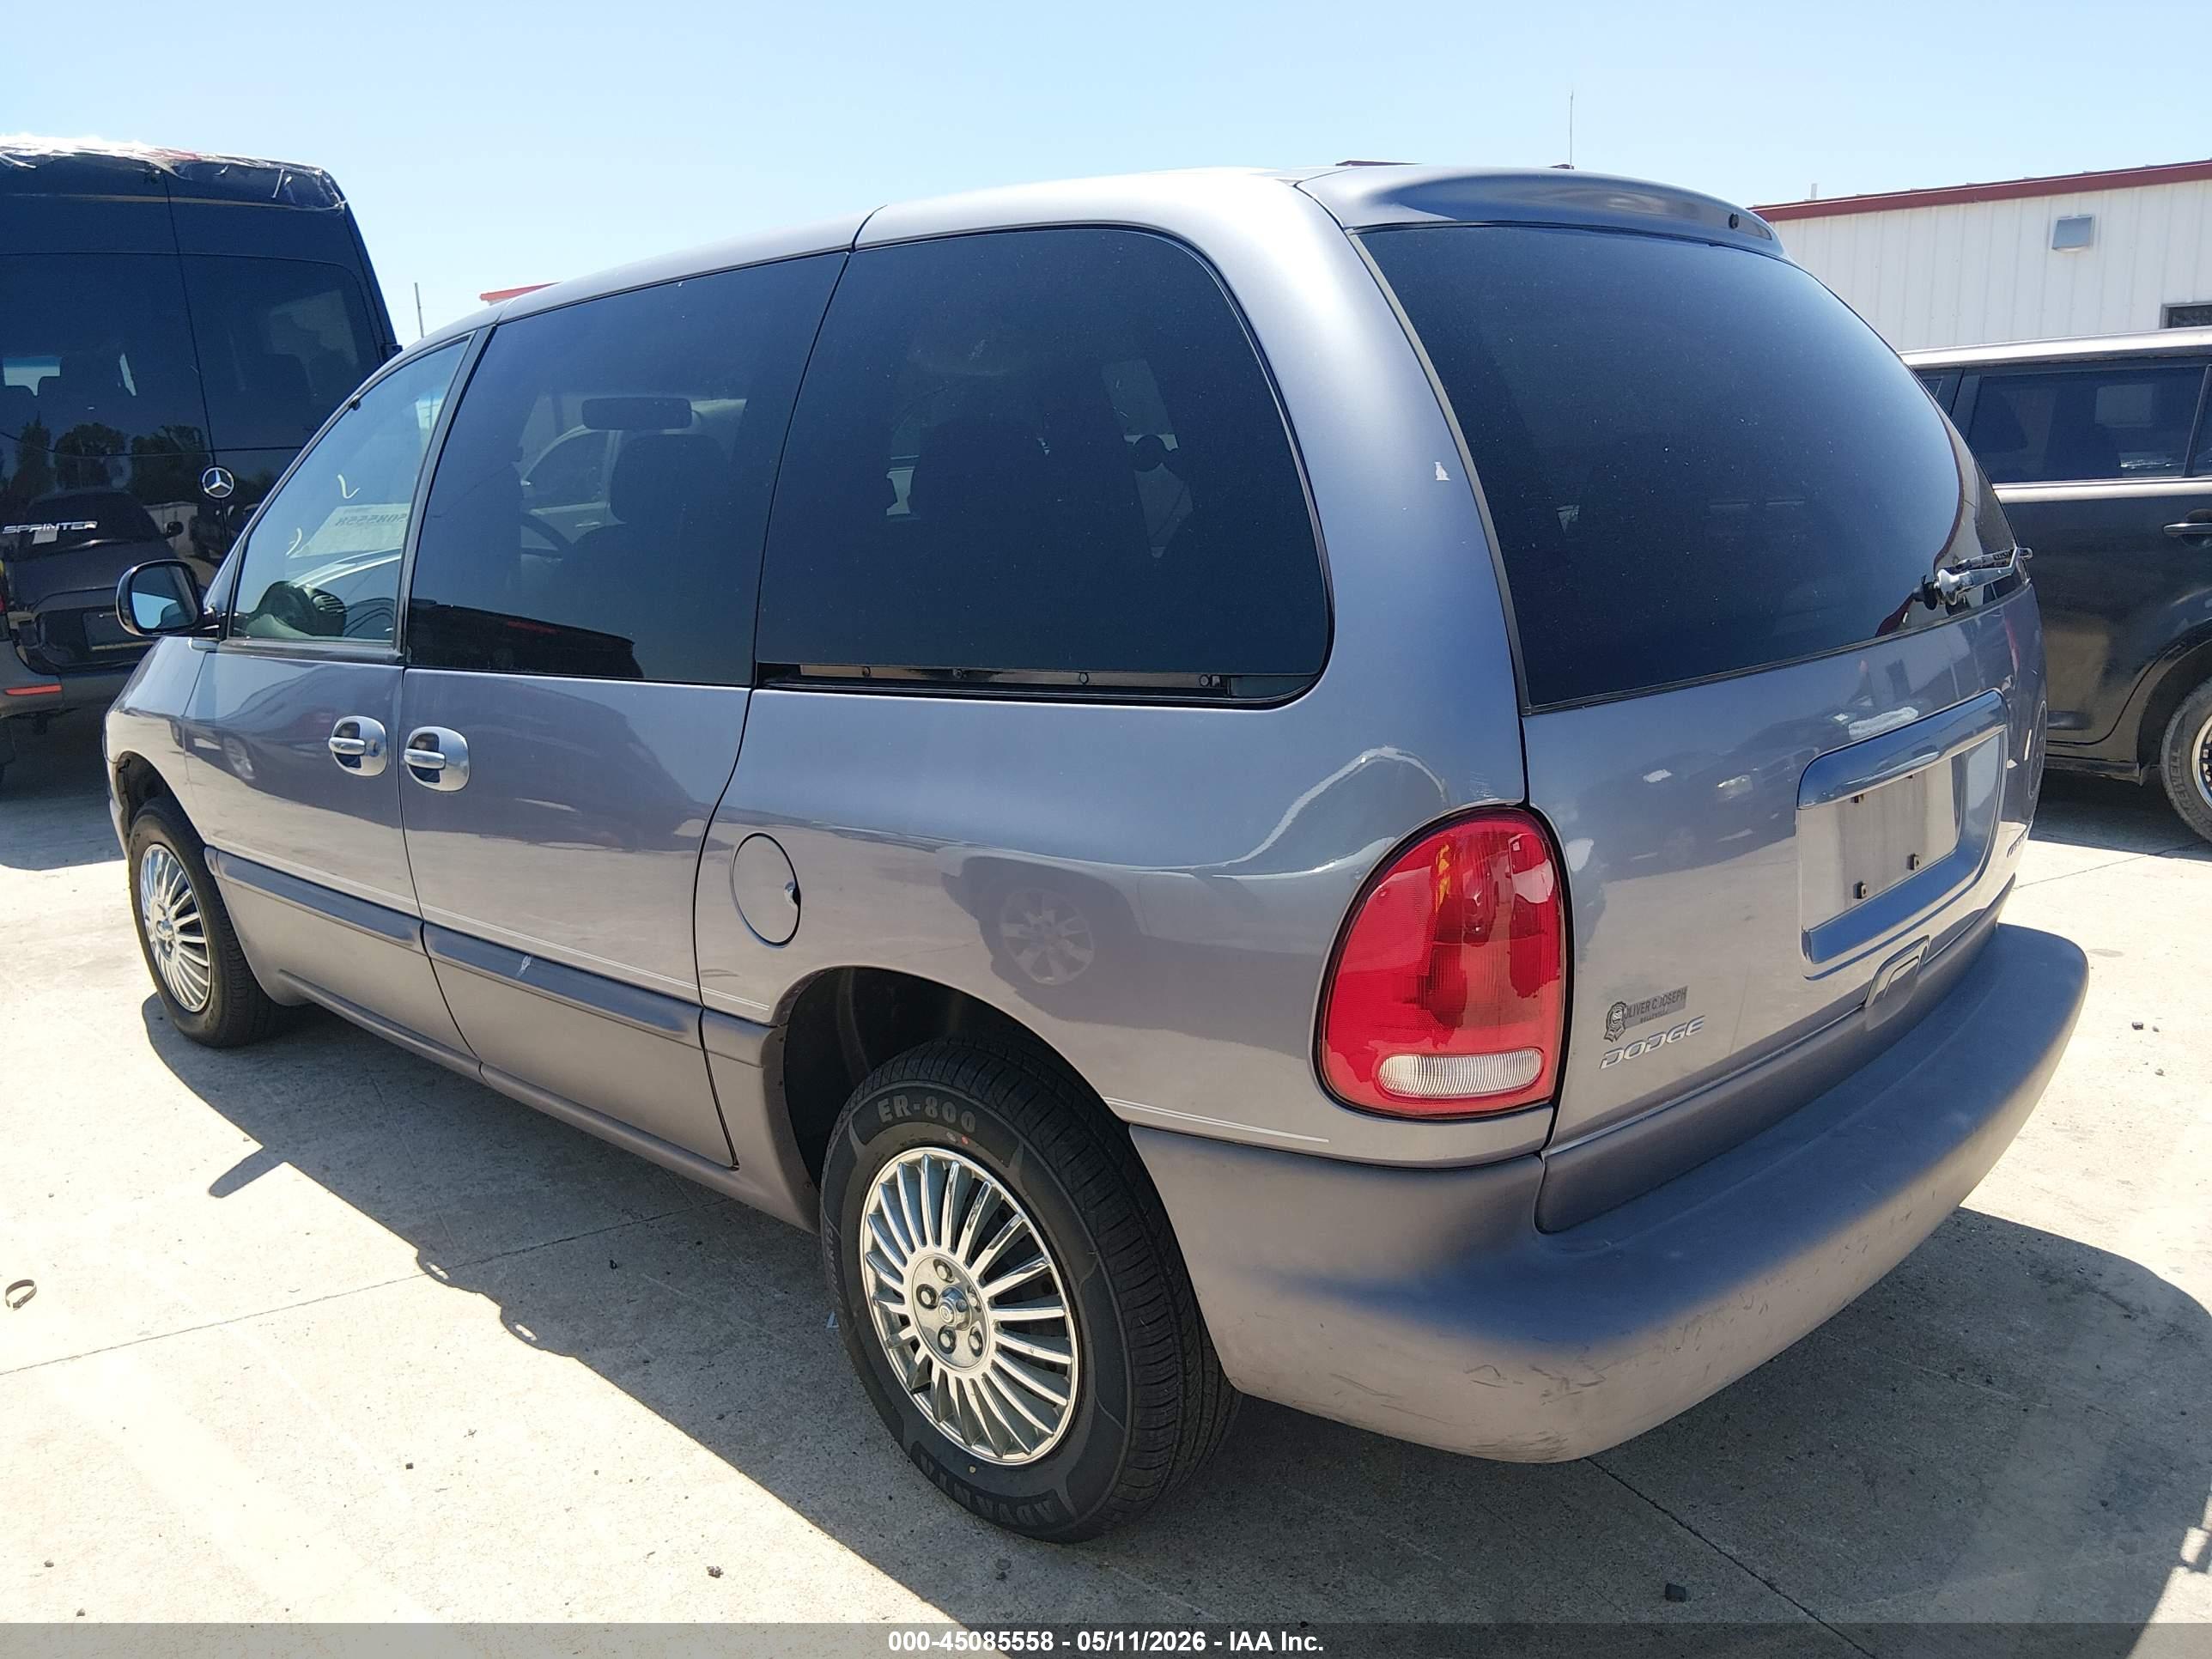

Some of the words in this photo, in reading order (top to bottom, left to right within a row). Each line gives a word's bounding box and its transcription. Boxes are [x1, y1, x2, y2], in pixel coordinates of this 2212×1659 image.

[3, 520, 98, 533] SPRINTER
[1659, 988, 1687, 1008] JOSEPH
[1600, 1015, 1705, 1070] DODGE
[878, 1095, 976, 1133] ER-800
